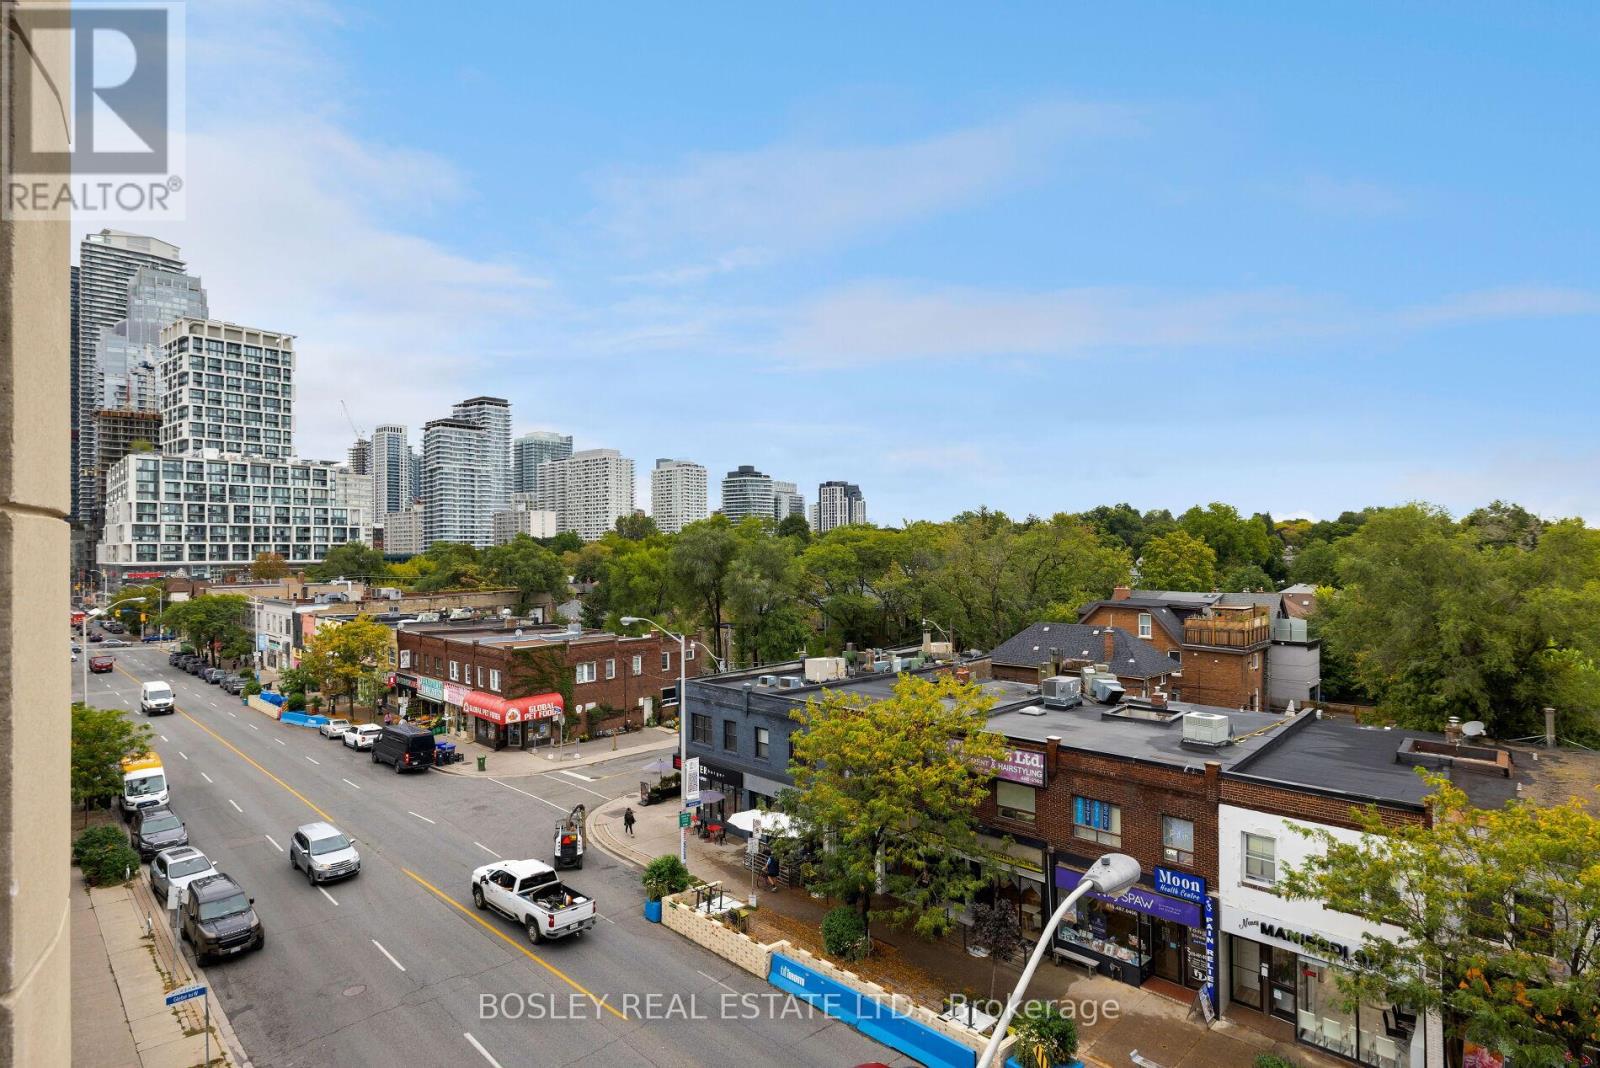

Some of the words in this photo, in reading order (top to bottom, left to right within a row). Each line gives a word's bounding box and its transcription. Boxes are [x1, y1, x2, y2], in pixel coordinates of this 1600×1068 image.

[524, 712, 537, 720] PET
[529, 702, 555, 714] GLOBAL
[1015, 751, 1044, 768] Ltd.
[998, 763, 1043, 778] HAIRSTYLING
[1159, 869, 1201, 893] Moon
[1160, 884, 1179, 896] Health
[1180, 889, 1201, 901] Centre
[1206, 917, 1214, 944] PAIN
[1207, 949, 1215, 989] RELIEF
